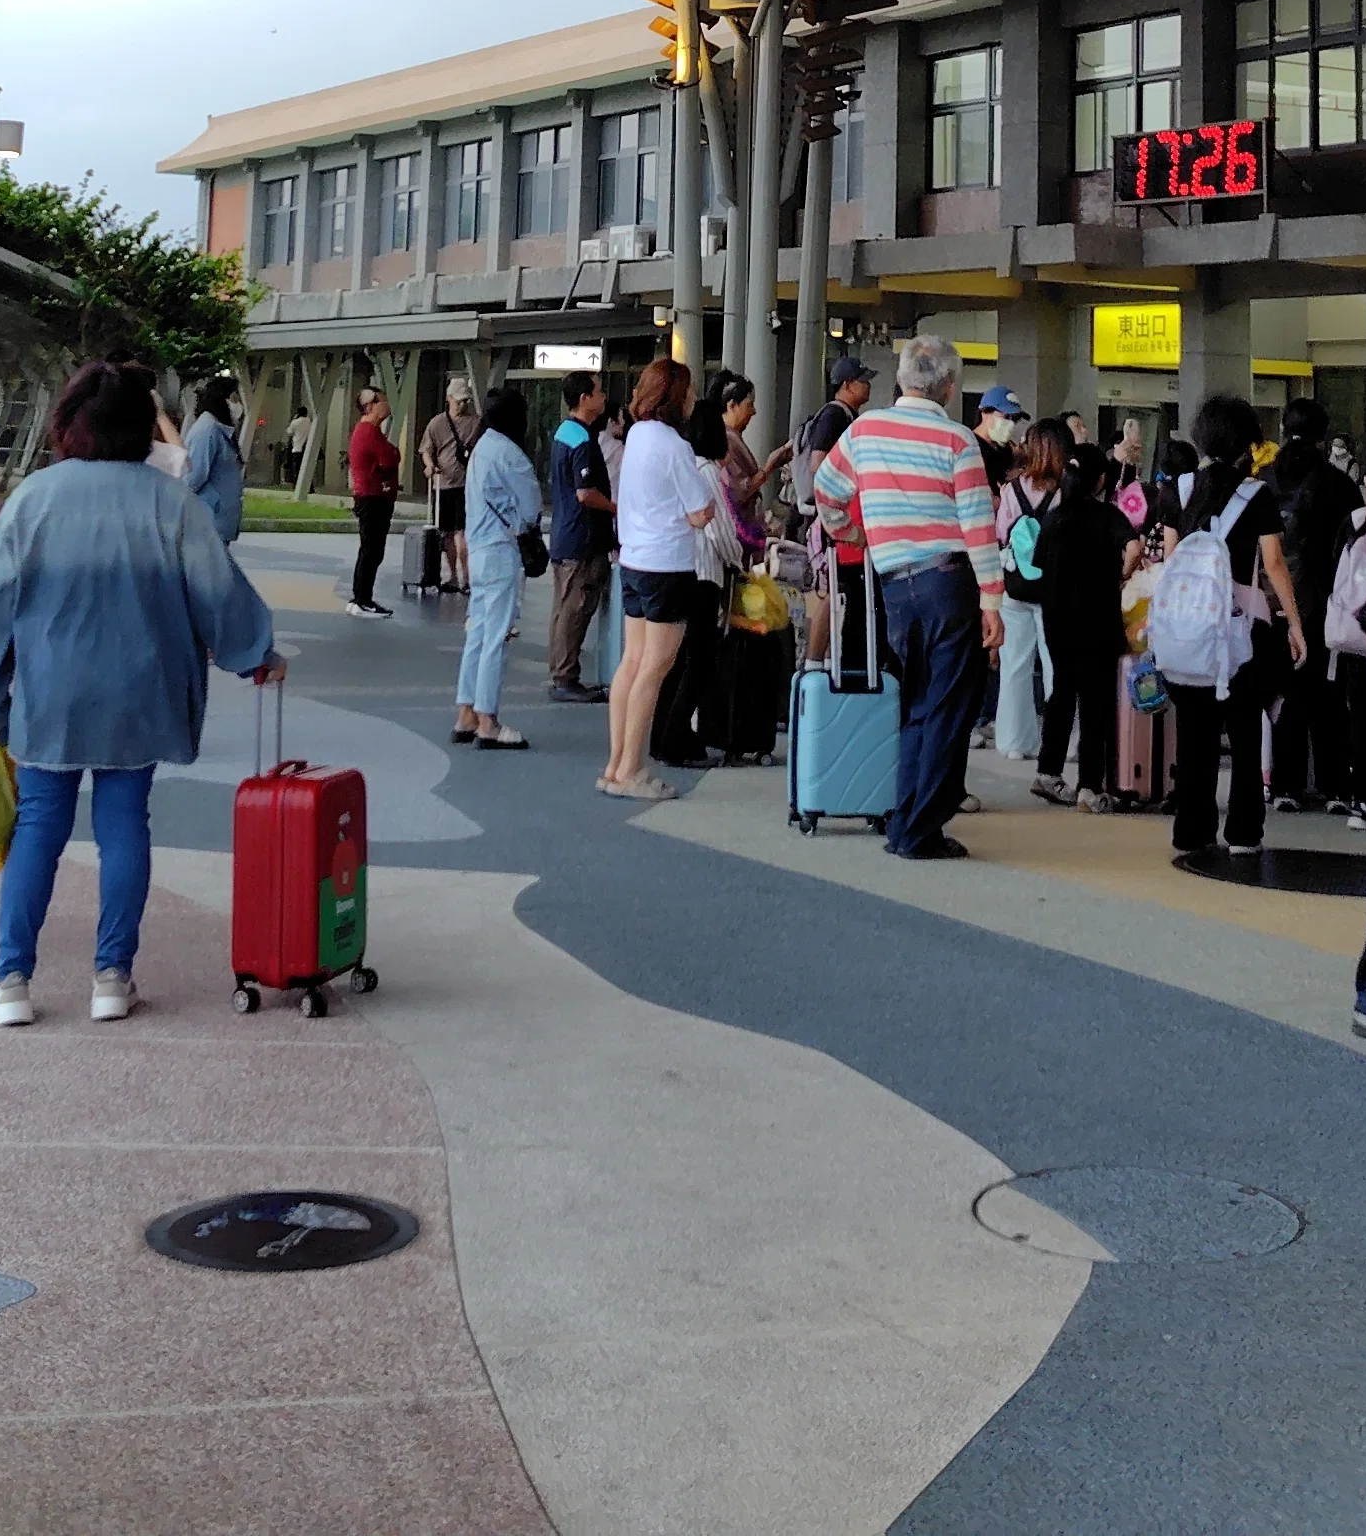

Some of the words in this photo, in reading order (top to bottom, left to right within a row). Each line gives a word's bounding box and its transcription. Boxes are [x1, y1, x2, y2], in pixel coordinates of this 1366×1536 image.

[1136, 120, 1257, 199] 17:26
[1117, 313, 1166, 339] 東出口
